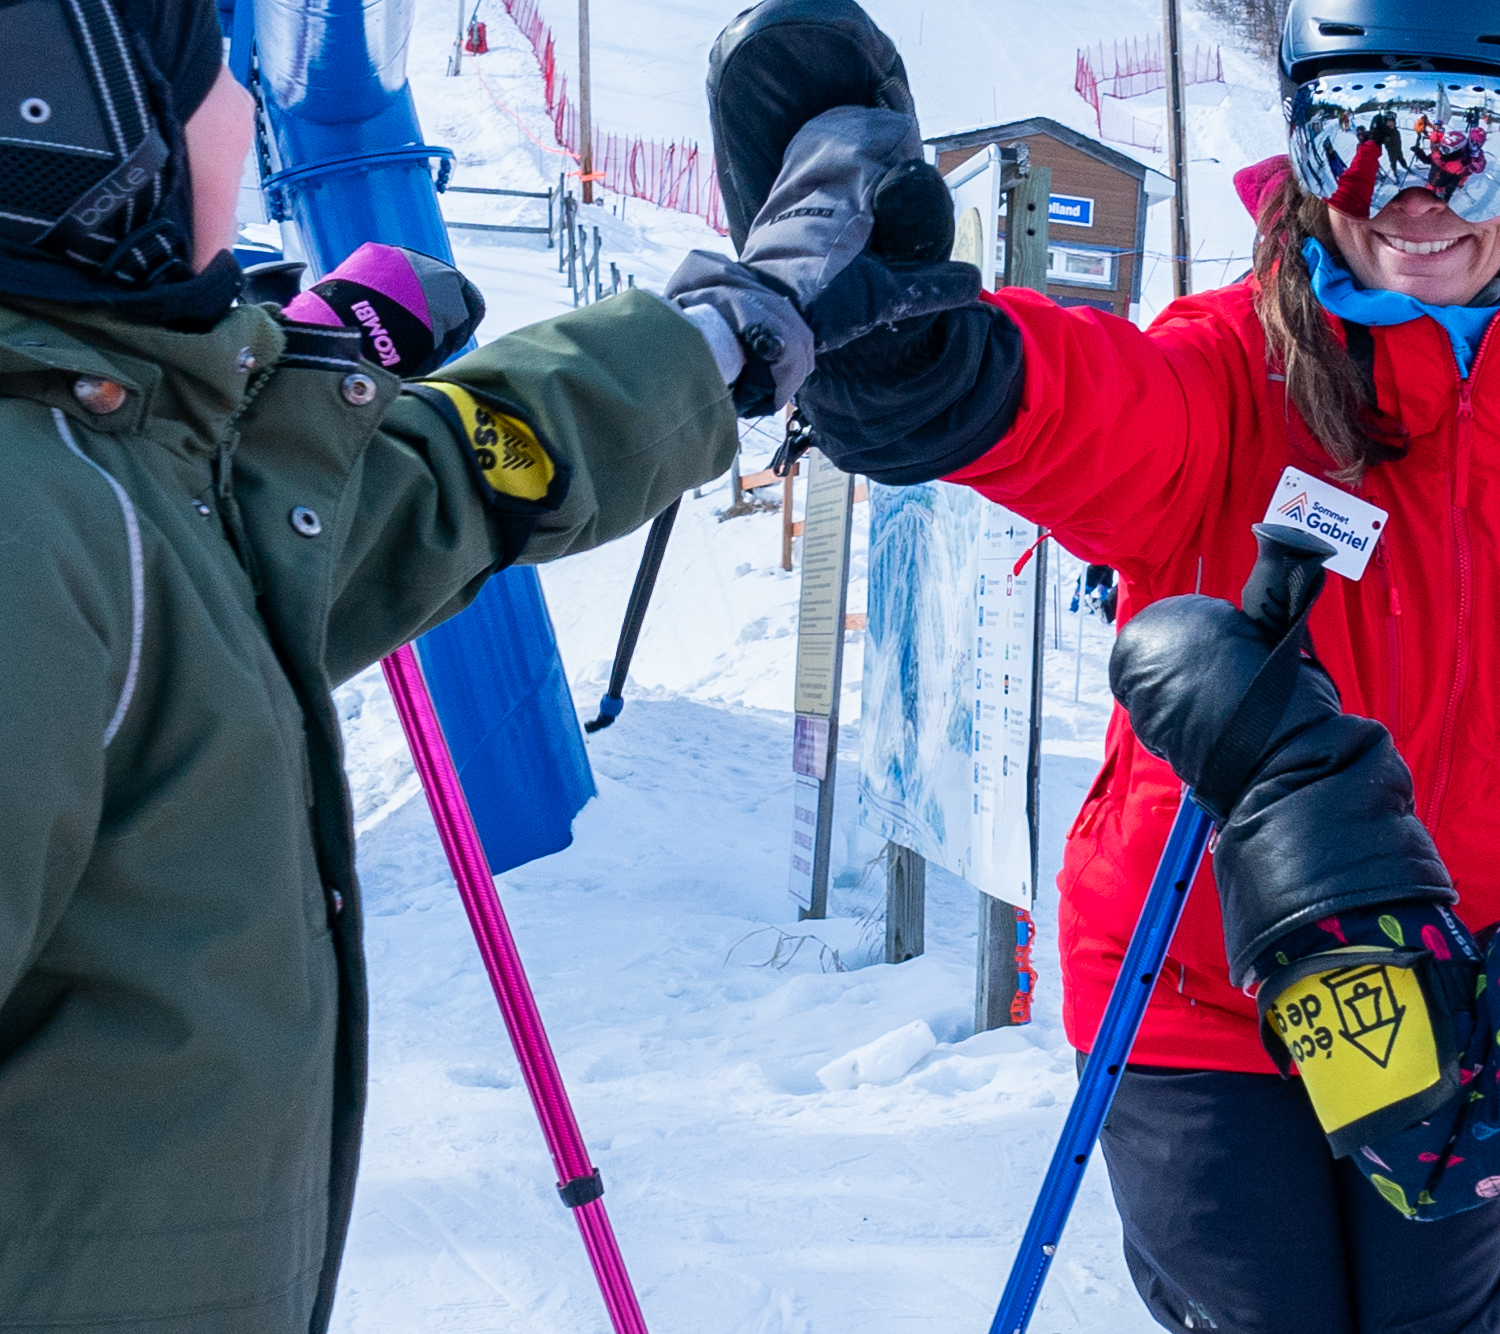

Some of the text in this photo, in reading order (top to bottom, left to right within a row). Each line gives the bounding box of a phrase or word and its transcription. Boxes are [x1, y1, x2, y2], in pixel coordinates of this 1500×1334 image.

[350, 299, 401, 367] KOMBI
[1306, 512, 1369, 552] Gabriel
[1311, 501, 1350, 525] Sommet
[1290, 1023, 1334, 1063] éco
